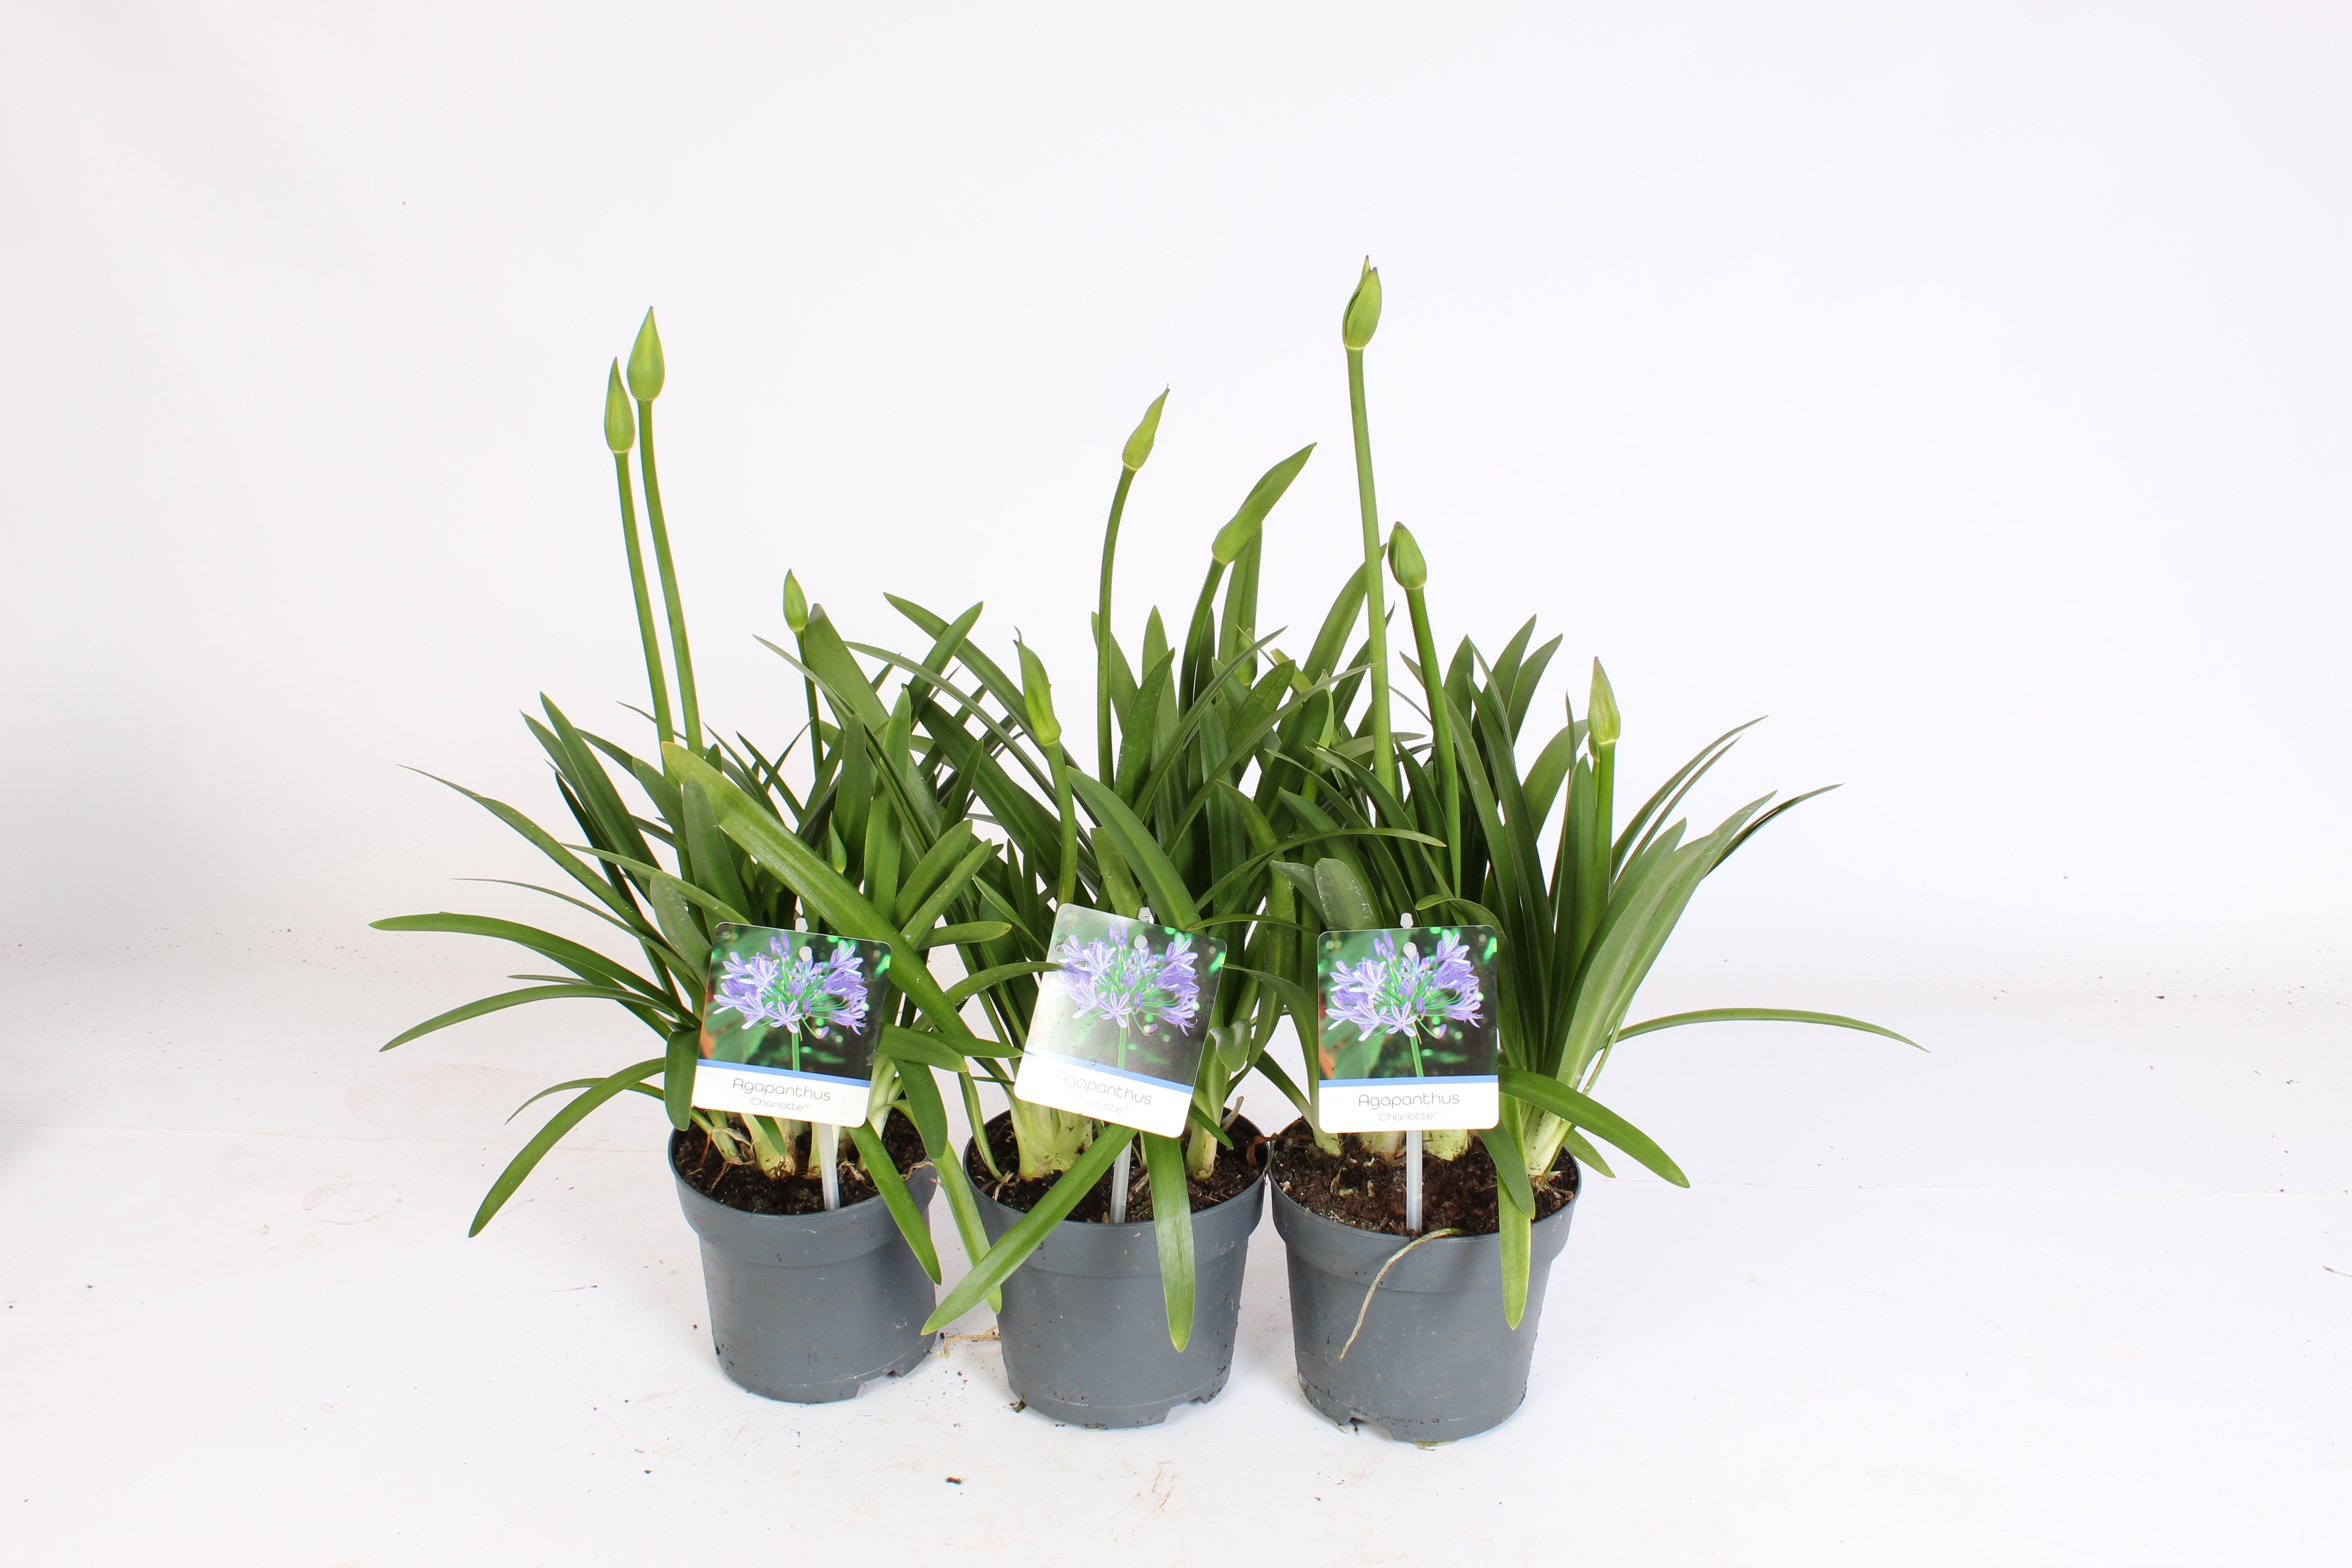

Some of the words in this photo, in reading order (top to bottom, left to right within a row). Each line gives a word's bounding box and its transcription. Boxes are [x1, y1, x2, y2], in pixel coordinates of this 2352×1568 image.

[732, 1078, 831, 1101] Agapanthus
[1056, 1071, 1152, 1105] Agapanthus
[1358, 1092, 1460, 1110] Agapanthus
